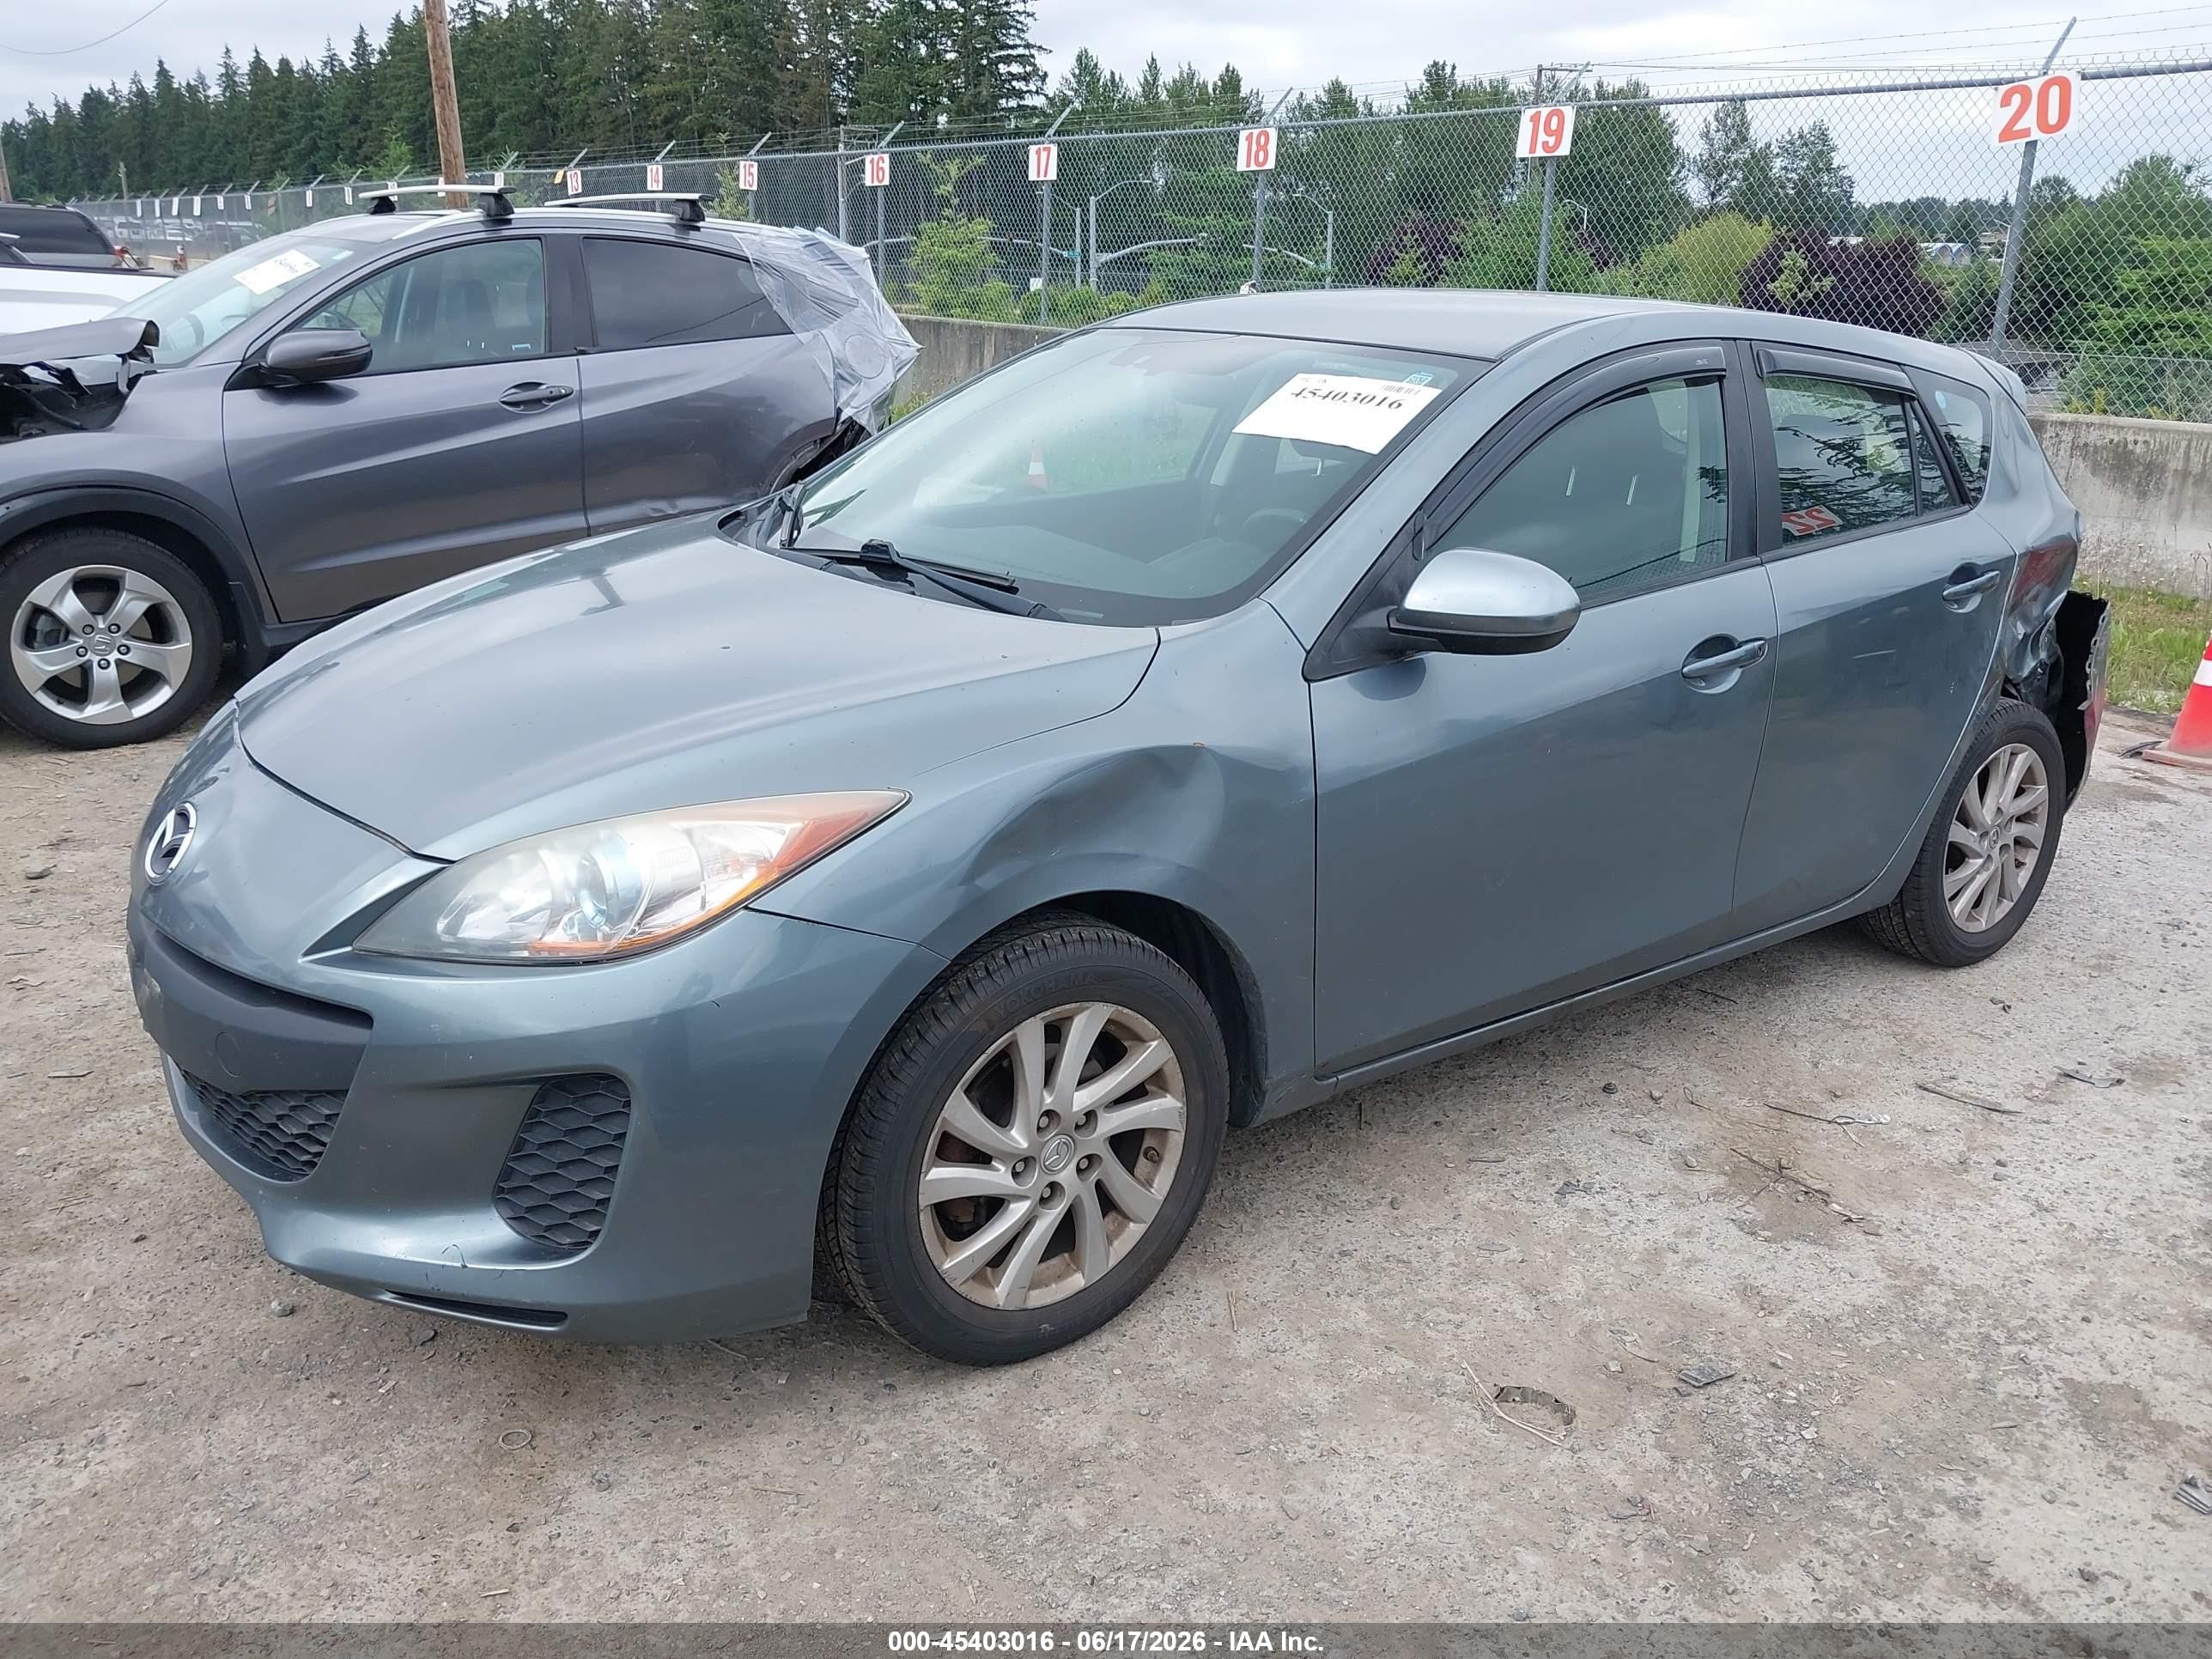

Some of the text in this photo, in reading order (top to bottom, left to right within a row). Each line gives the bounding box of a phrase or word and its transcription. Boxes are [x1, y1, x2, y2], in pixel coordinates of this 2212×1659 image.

[1998, 76, 2072, 143] 20
[1528, 108, 1565, 155] 19
[1035, 146, 1052, 178] 17
[1245, 130, 1270, 168] 18
[569, 172, 580, 192] 13
[649, 167, 660, 189] 14
[742, 163, 755, 188] 15
[869, 155, 886, 184] 16
[1291, 386, 1407, 410] 45403016
[997, 970, 1097, 1018] YOKOHAMA
